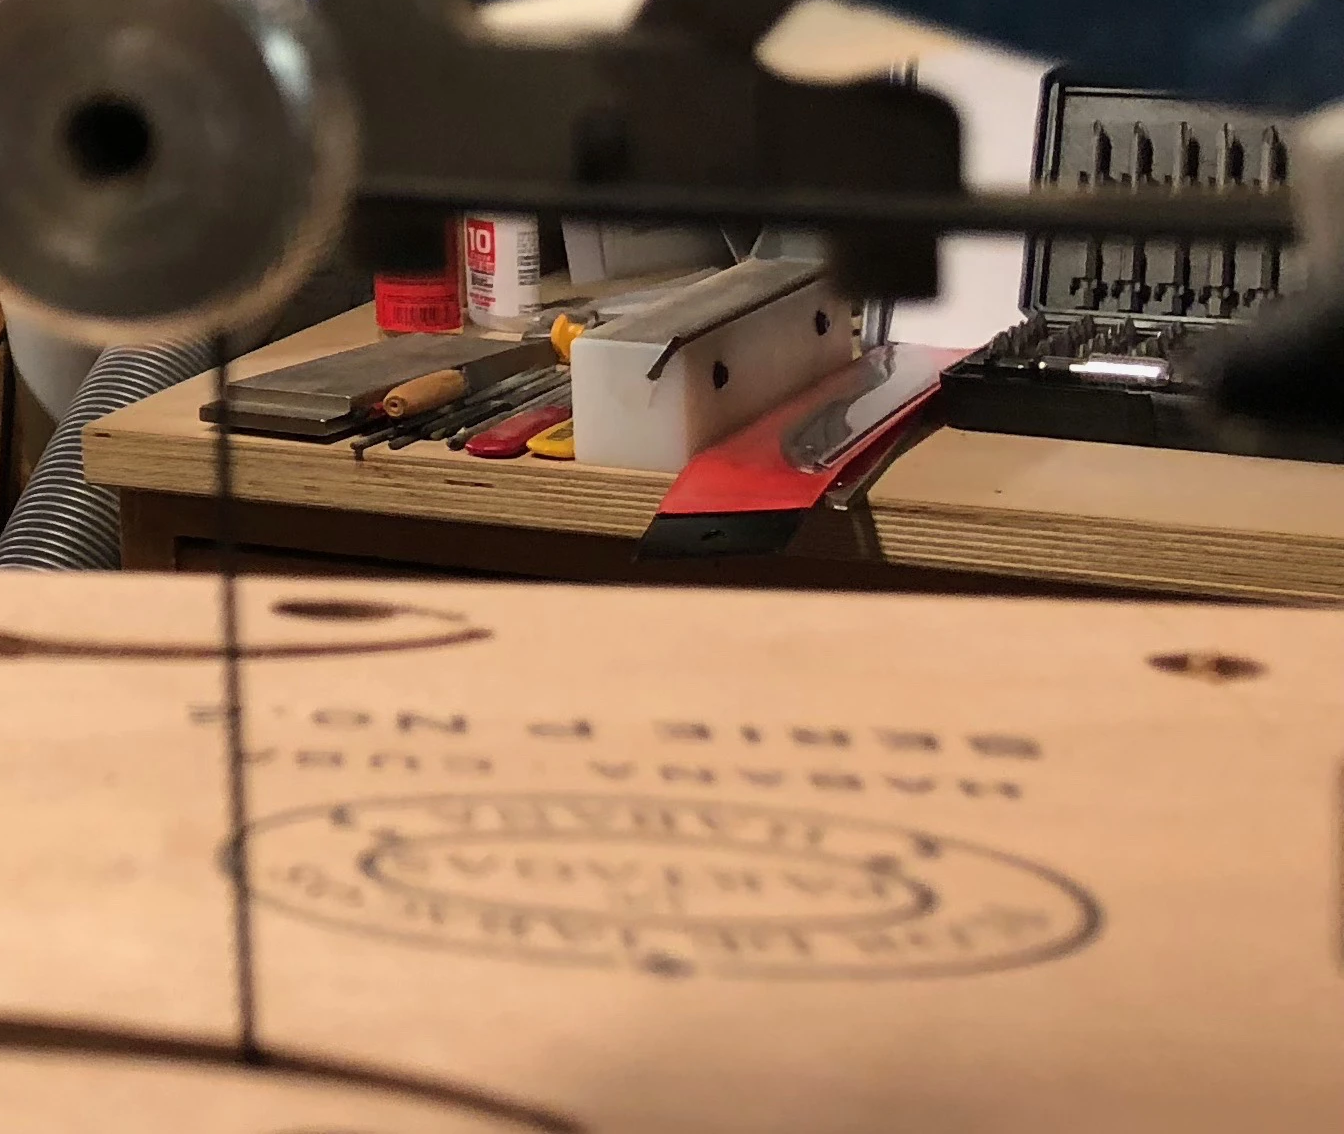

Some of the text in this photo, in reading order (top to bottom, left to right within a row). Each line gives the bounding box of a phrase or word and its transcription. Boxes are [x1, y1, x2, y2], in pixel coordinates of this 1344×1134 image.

[467, 226, 492, 254] 10
[525, 717, 596, 742] P
[652, 718, 1043, 762] SERIE
[588, 758, 1023, 800] HABANA
